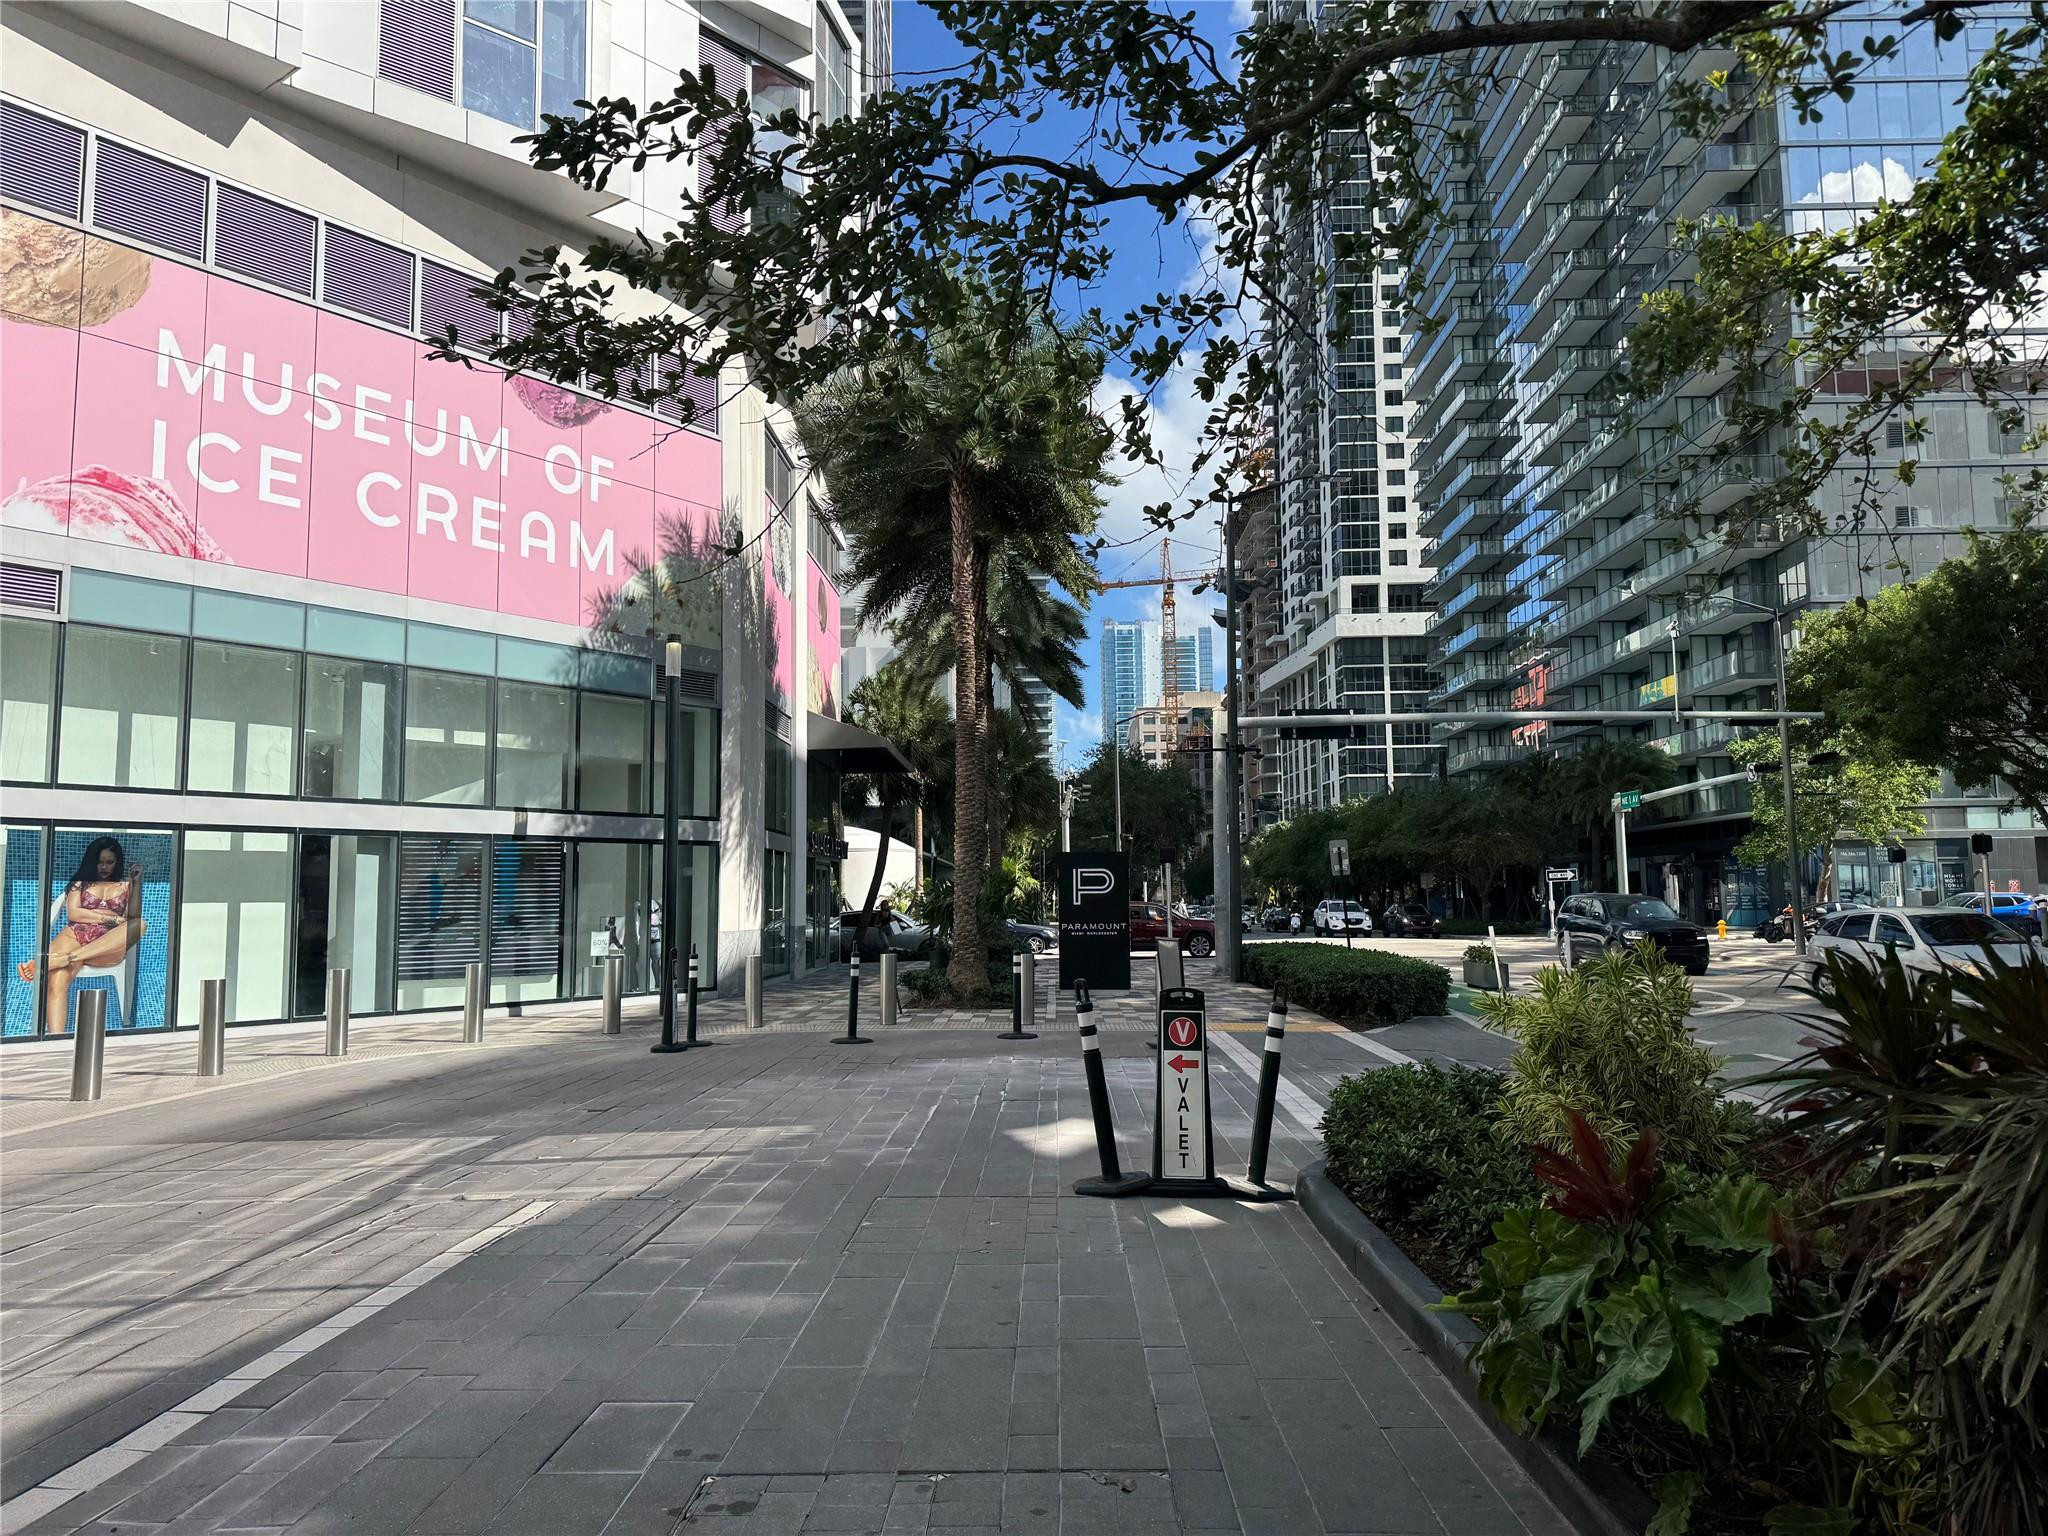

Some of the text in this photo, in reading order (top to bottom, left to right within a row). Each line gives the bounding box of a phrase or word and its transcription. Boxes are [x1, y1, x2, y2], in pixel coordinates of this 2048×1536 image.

[156, 328, 615, 502] MUSEUM OF
[152, 419, 615, 577] ICE CREAM
[1622, 797, 1628, 805] NE
[1632, 794, 1639, 802] AV
[1072, 868, 1115, 906] P
[1175, 1021, 1191, 1042] V
[1177, 1077, 1190, 1169] VALET
